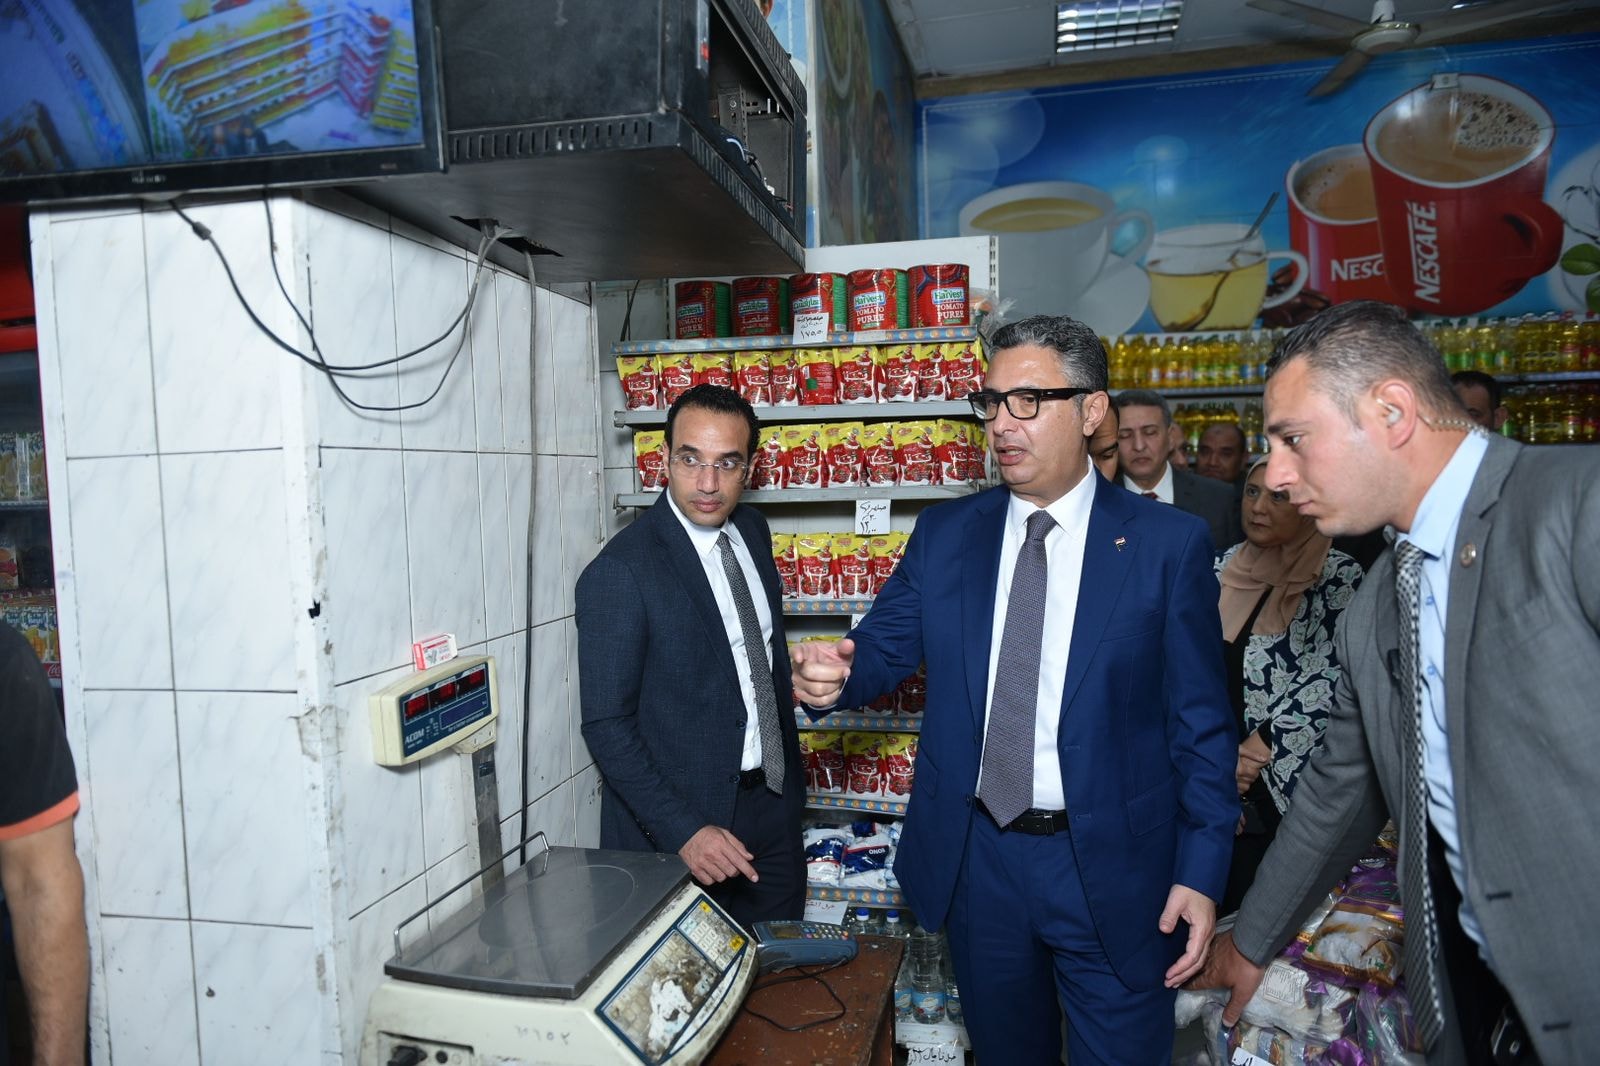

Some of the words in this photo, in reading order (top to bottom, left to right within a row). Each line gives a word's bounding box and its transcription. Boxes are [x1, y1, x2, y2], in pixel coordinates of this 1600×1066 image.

[1405, 200, 1441, 304] NESCAFÉ
[854, 293, 883, 305] Harvest
[933, 289, 964, 300] Harvest
[856, 306, 886, 317] TOMATO
[935, 302, 966, 311] TOMATO
[856, 313, 886, 325] PUREE
[936, 310, 966, 319] PUREE
